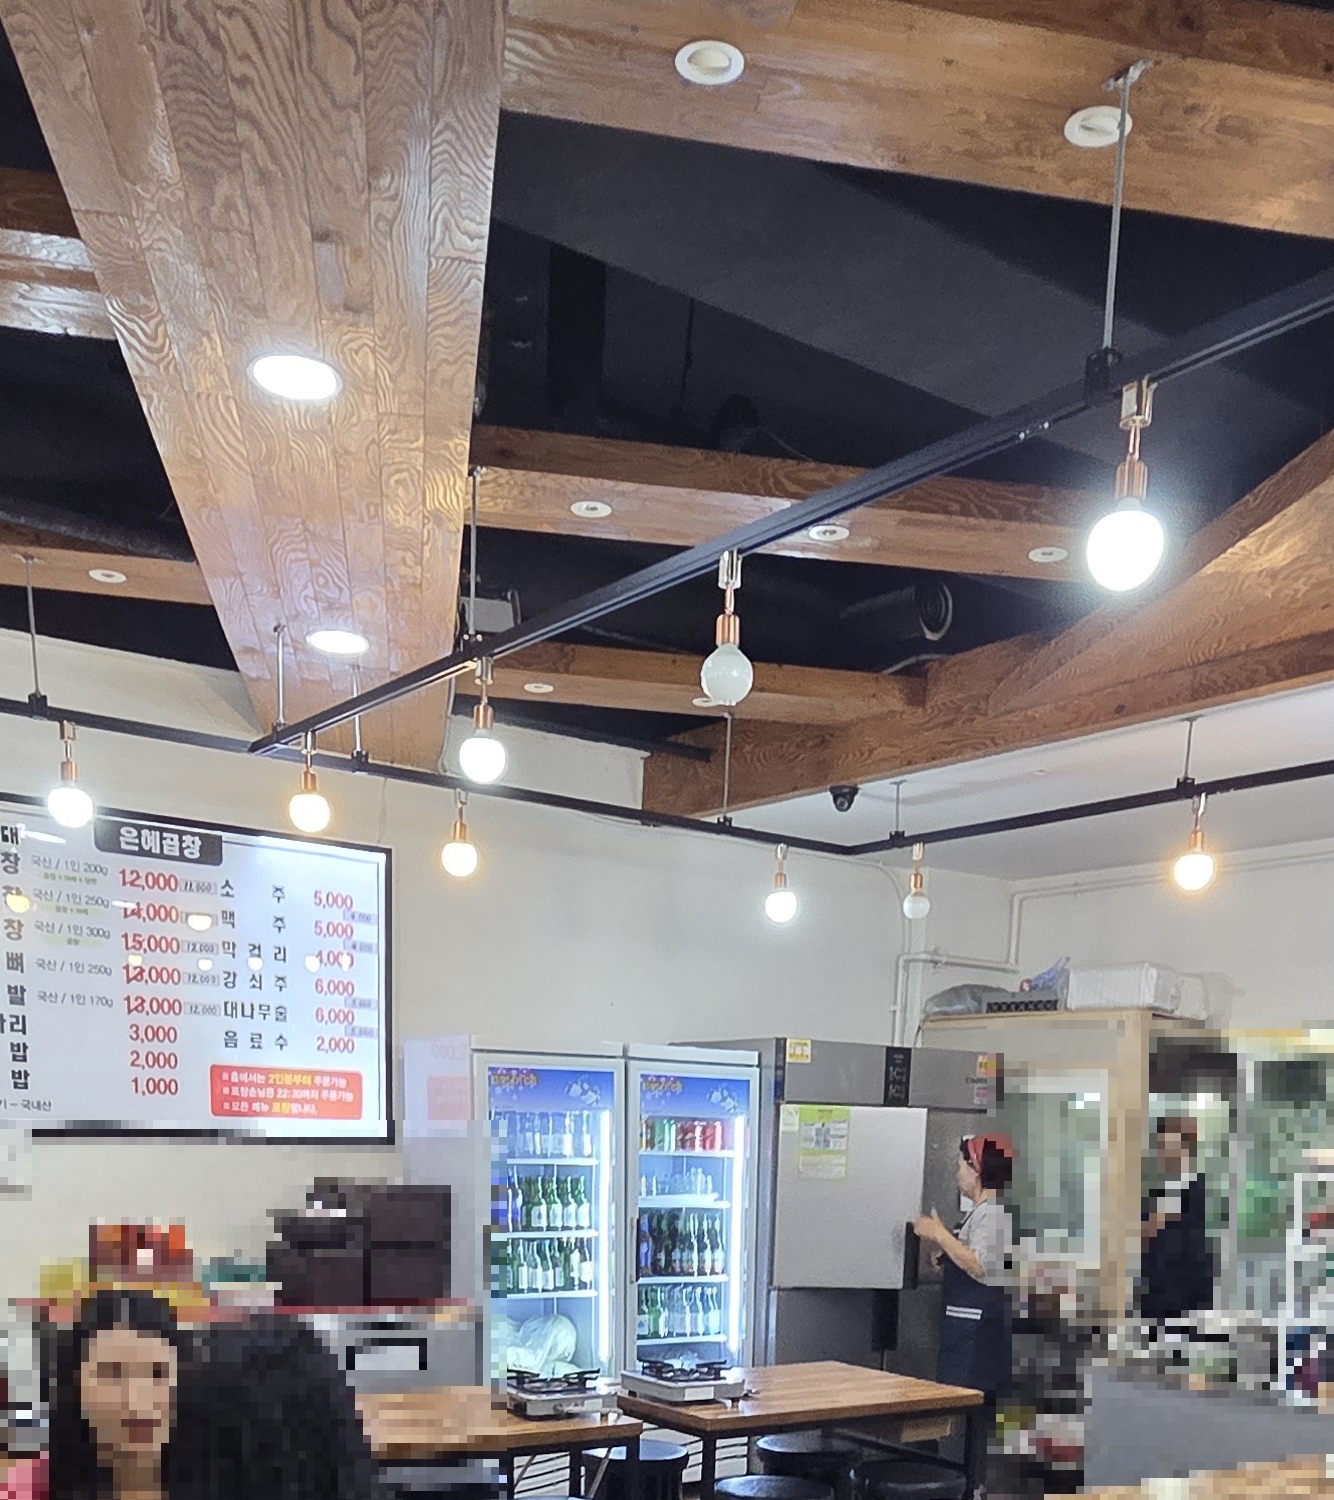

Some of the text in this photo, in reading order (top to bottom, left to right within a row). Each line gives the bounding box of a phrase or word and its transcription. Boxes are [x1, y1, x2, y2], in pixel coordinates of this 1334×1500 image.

[120, 826, 201, 859] 은혜곱창
[31, 855, 52, 870] 국산
[65, 860, 80, 872] 1인
[84, 862, 108, 876] 200g
[119, 868, 178, 892] 12,000
[33, 888, 54, 902] 국산
[66, 893, 82, 905] 1인
[85, 895, 109, 909] 250g
[314, 890, 353, 910] 5,000
[34, 920, 55, 933] 국산
[67, 924, 83, 936] 1인
[86, 925, 111, 939] 300g
[314, 920, 353, 940] 5,000
[121, 932, 180, 954] 15,000
[222, 941, 286, 963] 막걸리
[35, 958, 56, 971] 국산
[69, 961, 85, 974] 1인
[88, 963, 112, 976] 250g
[315, 978, 354, 997] 6,000
[37, 991, 58, 1004] 국산
[70, 994, 86, 1006] 1인
[89, 995, 113, 1008] 170g
[315, 1007, 354, 1026] 6,000
[129, 1023, 177, 1044] 3,000
[224, 1030, 288, 1051] 음료수
[316, 1036, 354, 1053] 2,000
[130, 1050, 178, 1070] 2,000
[131, 1077, 178, 1096] 1,000
[21, 1099, 52, 1112] 국내산
